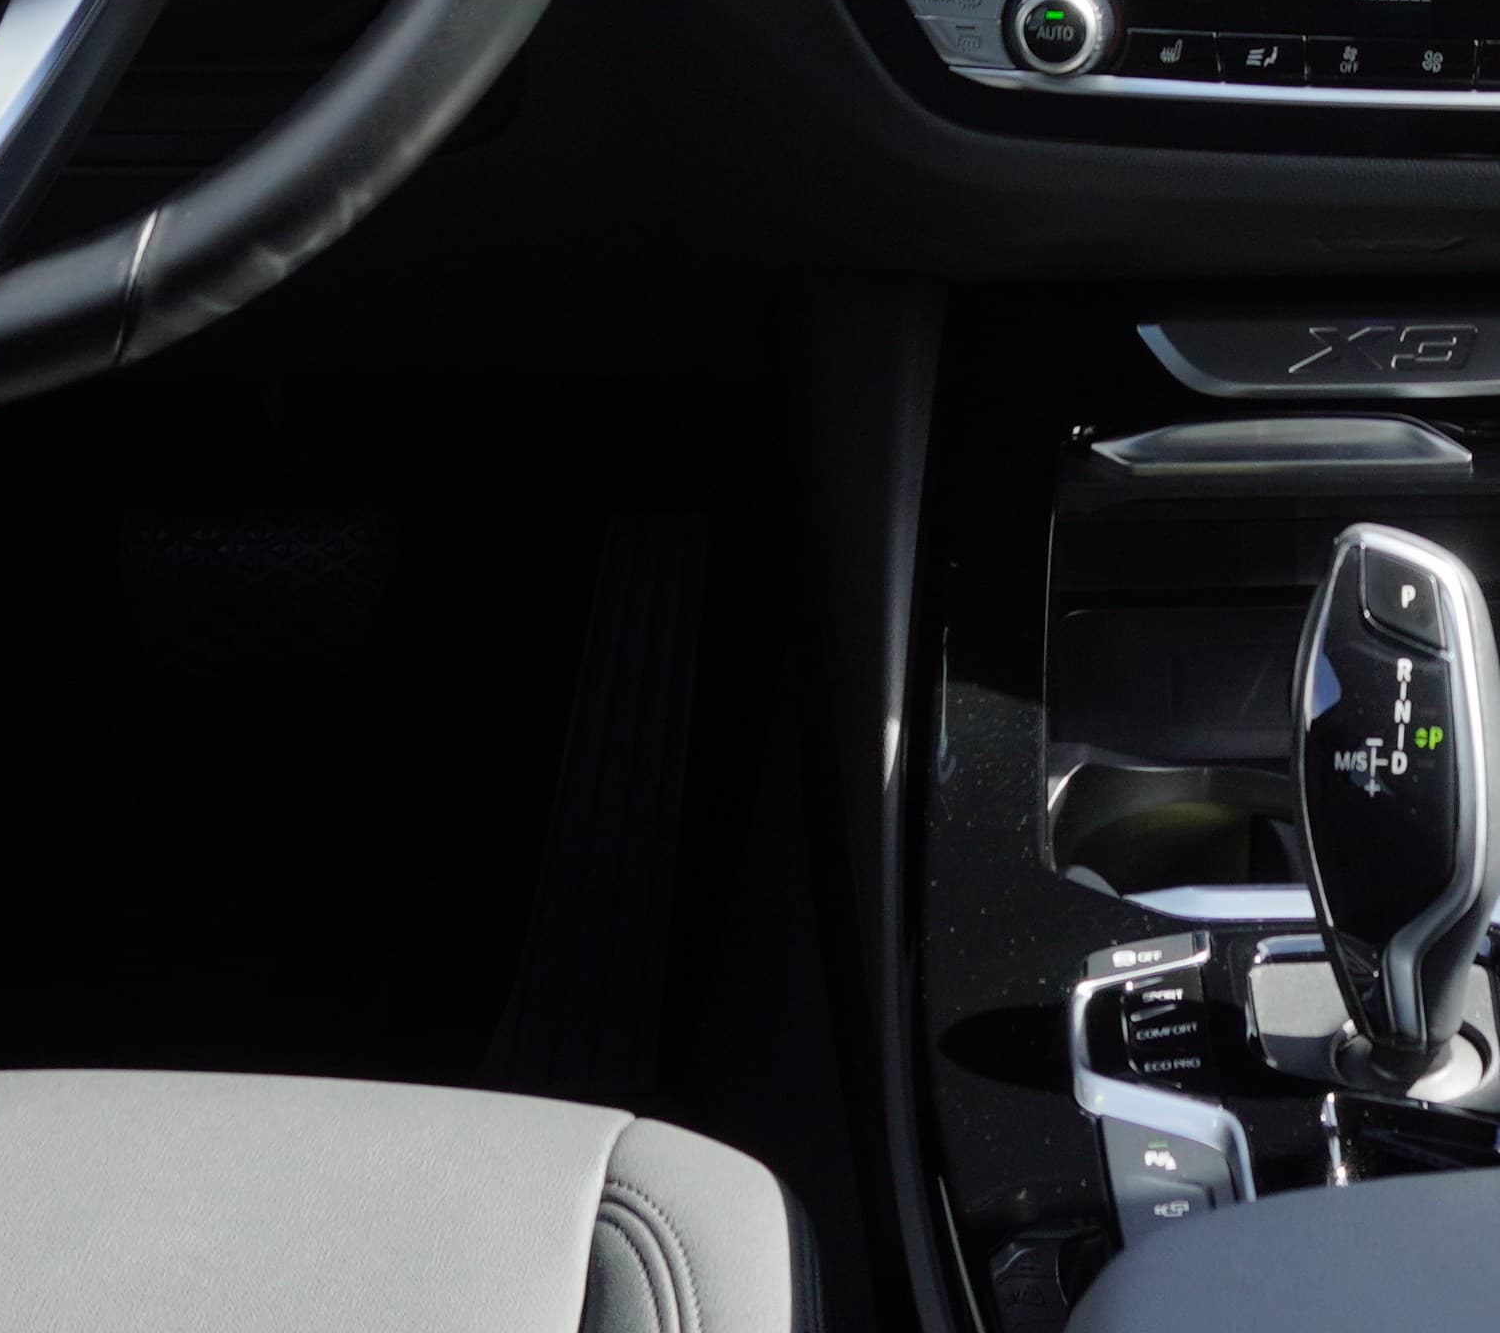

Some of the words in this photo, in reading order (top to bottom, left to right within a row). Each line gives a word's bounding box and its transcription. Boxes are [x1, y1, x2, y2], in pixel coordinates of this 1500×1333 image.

[1035, 25, 1075, 42] AUTO
[1339, 61, 1359, 74] OFF
[1401, 584, 1416, 609] P
[1396, 657, 1413, 683] R
[1394, 699, 1412, 724] N
[1334, 750, 1368, 772] M/S
[1391, 750, 1408, 775] D
[1137, 950, 1162, 964] OFF
[1141, 988, 1184, 1004] SPORT
[1135, 1021, 1198, 1041] COMFORT
[1144, 1061, 1173, 1074] ECO
[1173, 1057, 1202, 1070] PRO
